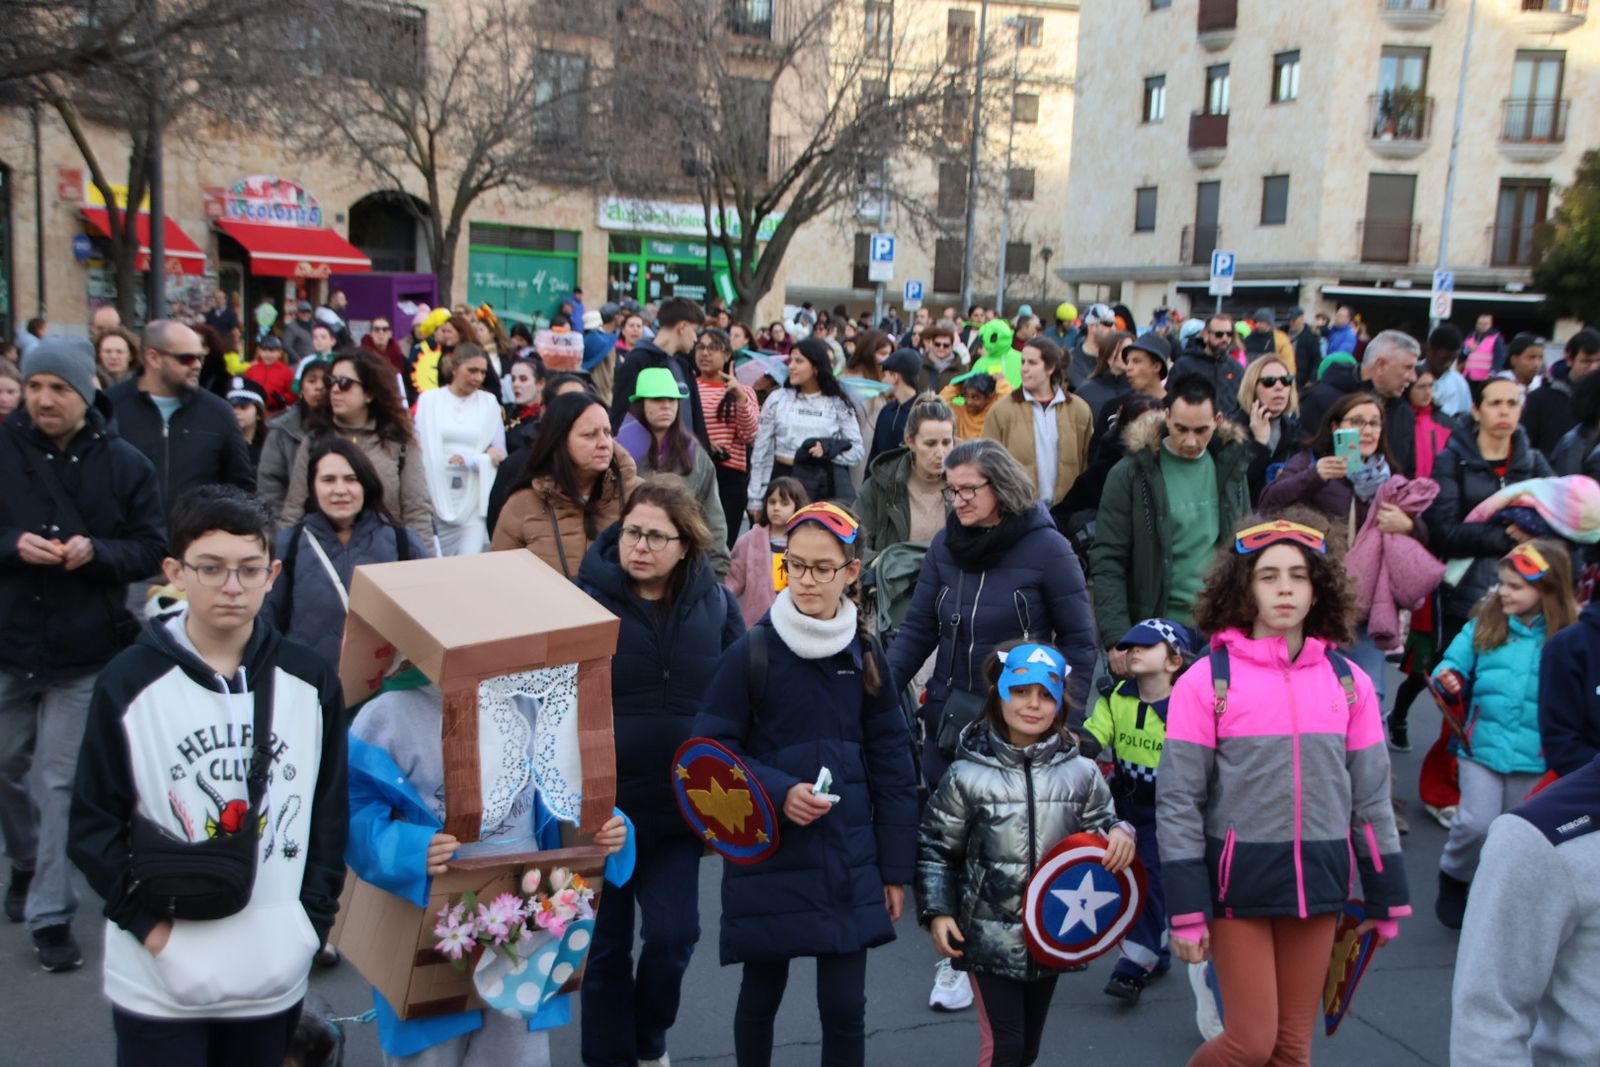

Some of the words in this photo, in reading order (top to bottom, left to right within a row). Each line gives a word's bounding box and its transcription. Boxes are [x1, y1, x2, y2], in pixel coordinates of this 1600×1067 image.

[875, 236, 891, 260] P
[1216, 253, 1232, 275] P
[532, 269, 547, 294] 4
[907, 281, 920, 299] P
[177, 723, 289, 765] HELLFE
[209, 758, 273, 786] CLU
